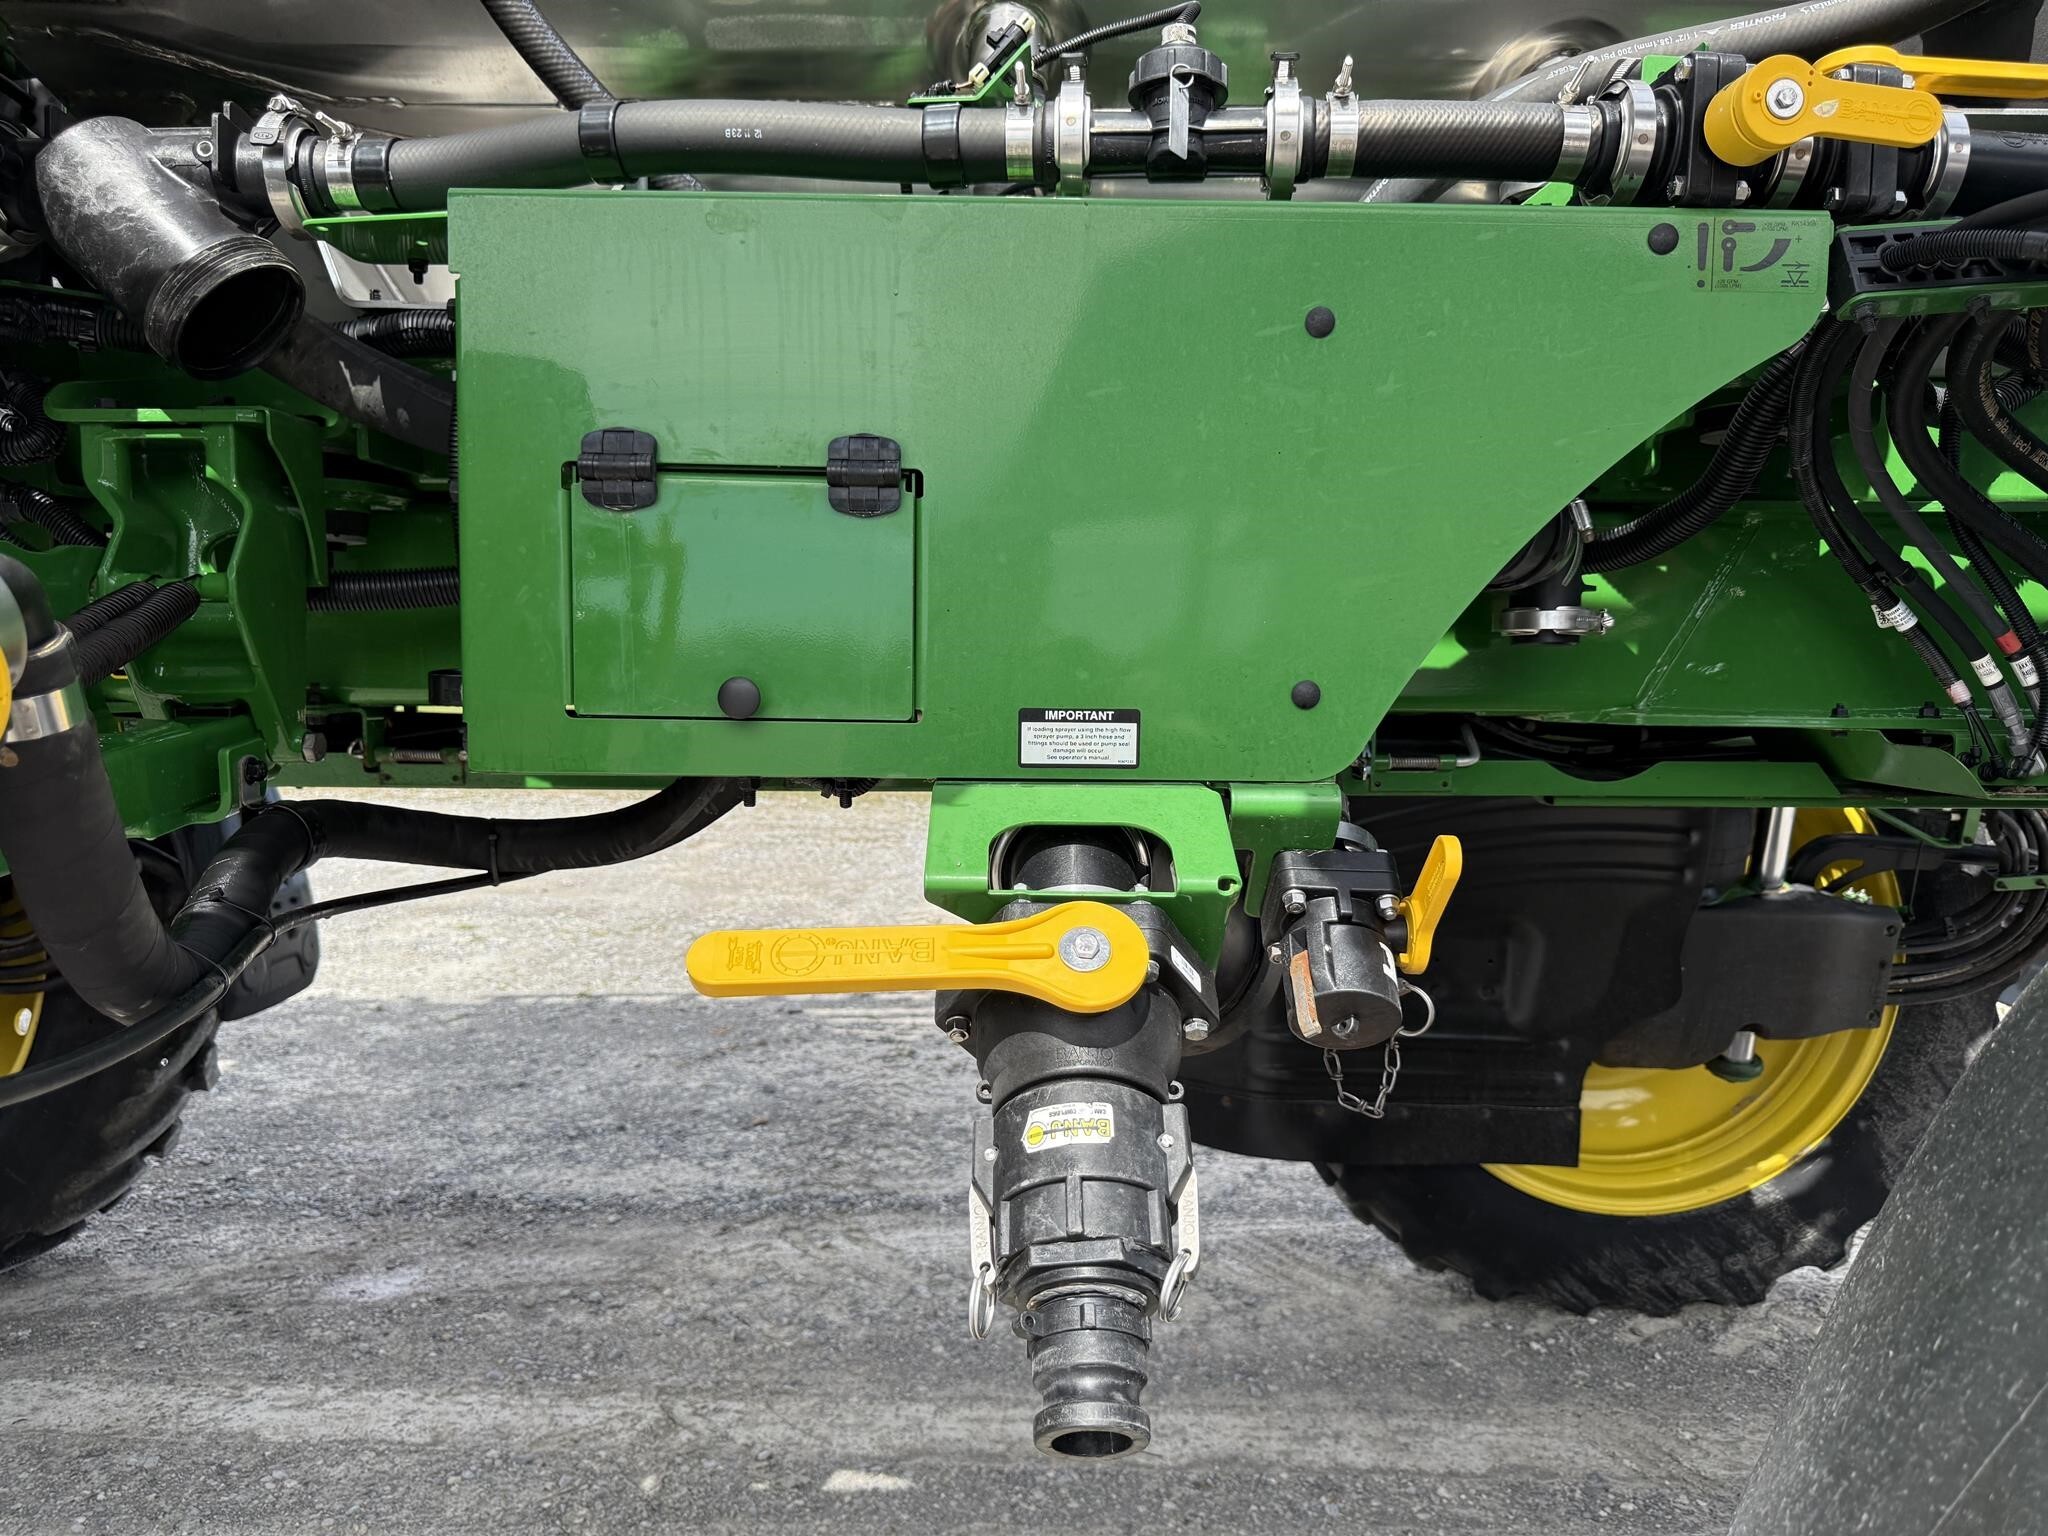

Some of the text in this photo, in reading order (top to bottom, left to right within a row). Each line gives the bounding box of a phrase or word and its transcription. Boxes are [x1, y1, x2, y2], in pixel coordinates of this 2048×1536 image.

[1729, 11, 1788, 31] FRONTIER
[1617, 46, 1633, 57] 200
[1044, 710, 1115, 721] IMPORTANT
